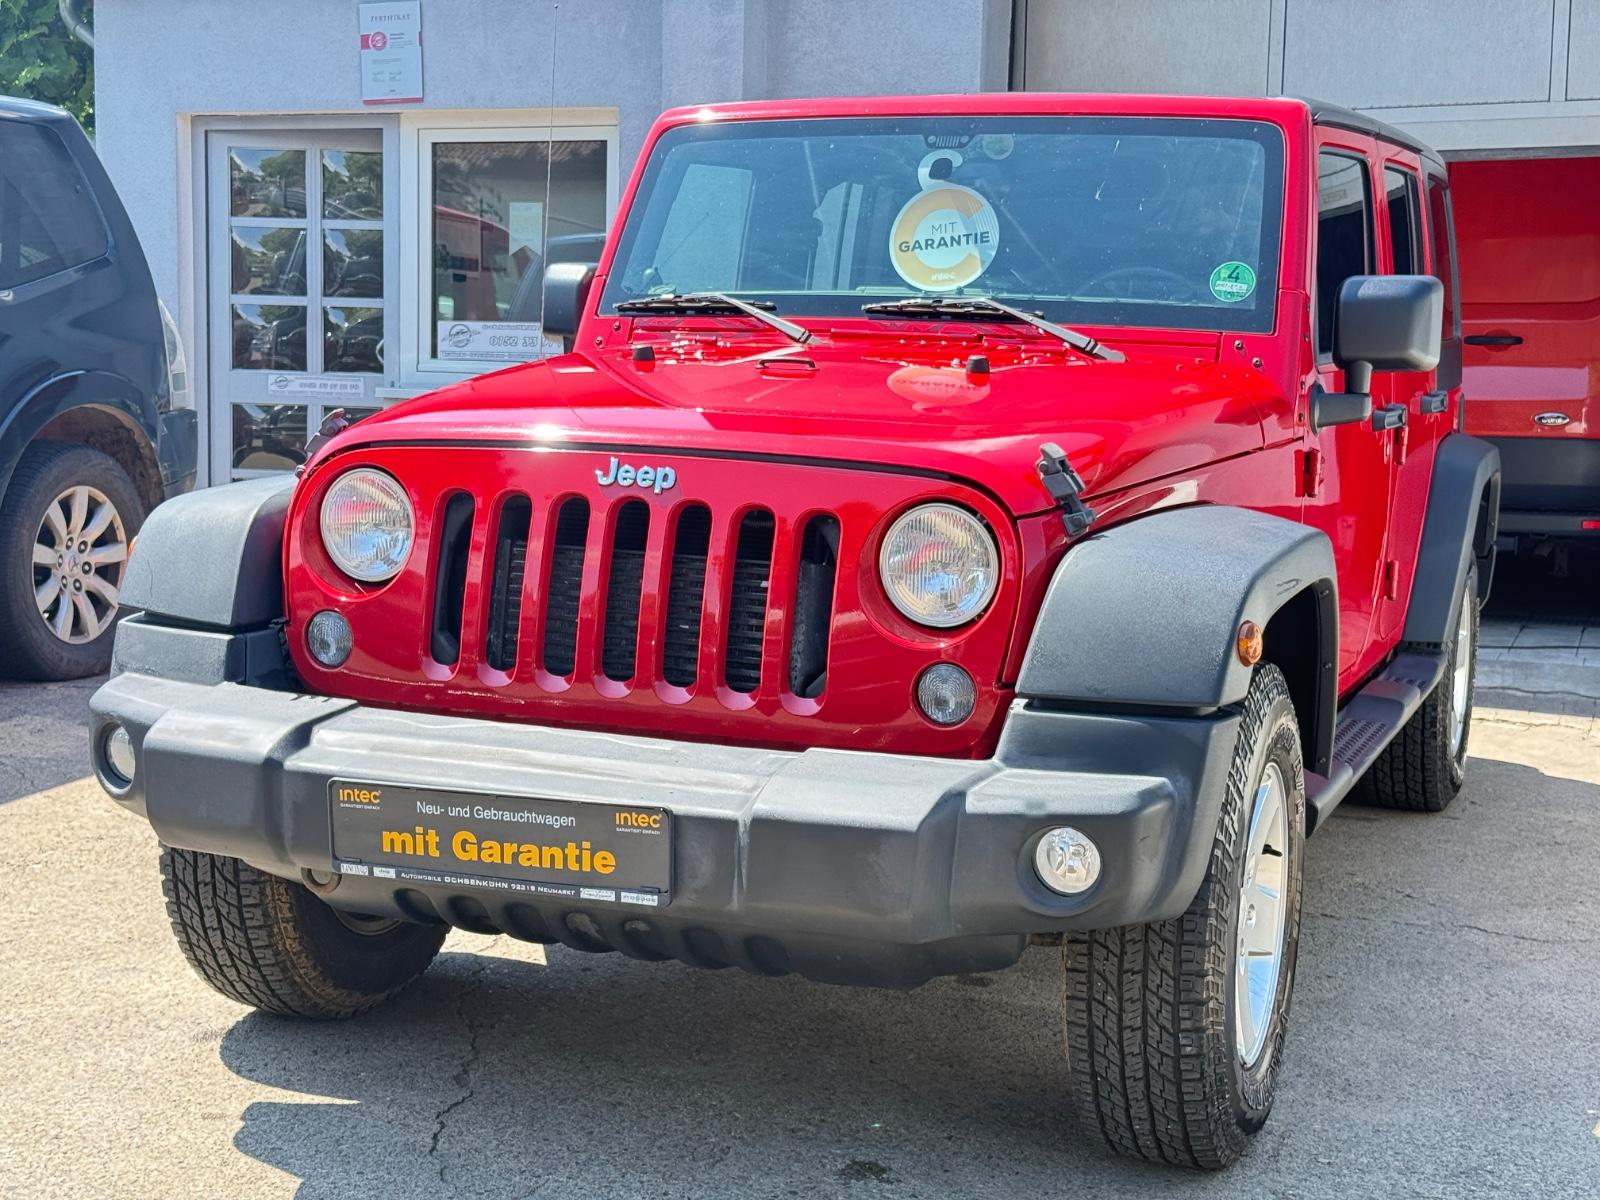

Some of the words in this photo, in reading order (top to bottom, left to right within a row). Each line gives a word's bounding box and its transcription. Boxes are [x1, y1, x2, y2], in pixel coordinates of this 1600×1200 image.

[931, 221, 959, 235] MIT
[898, 231, 991, 253] GARANTIE
[1227, 265, 1241, 283] 4
[595, 456, 677, 494] Jeep
[339, 788, 381, 804] intec
[416, 801, 445, 815] Neu-
[448, 805, 470, 818] und
[473, 806, 576, 829] Gebrauchtwagen
[615, 811, 662, 828] intec
[382, 826, 440, 858] mit
[452, 829, 617, 875] Garantie
